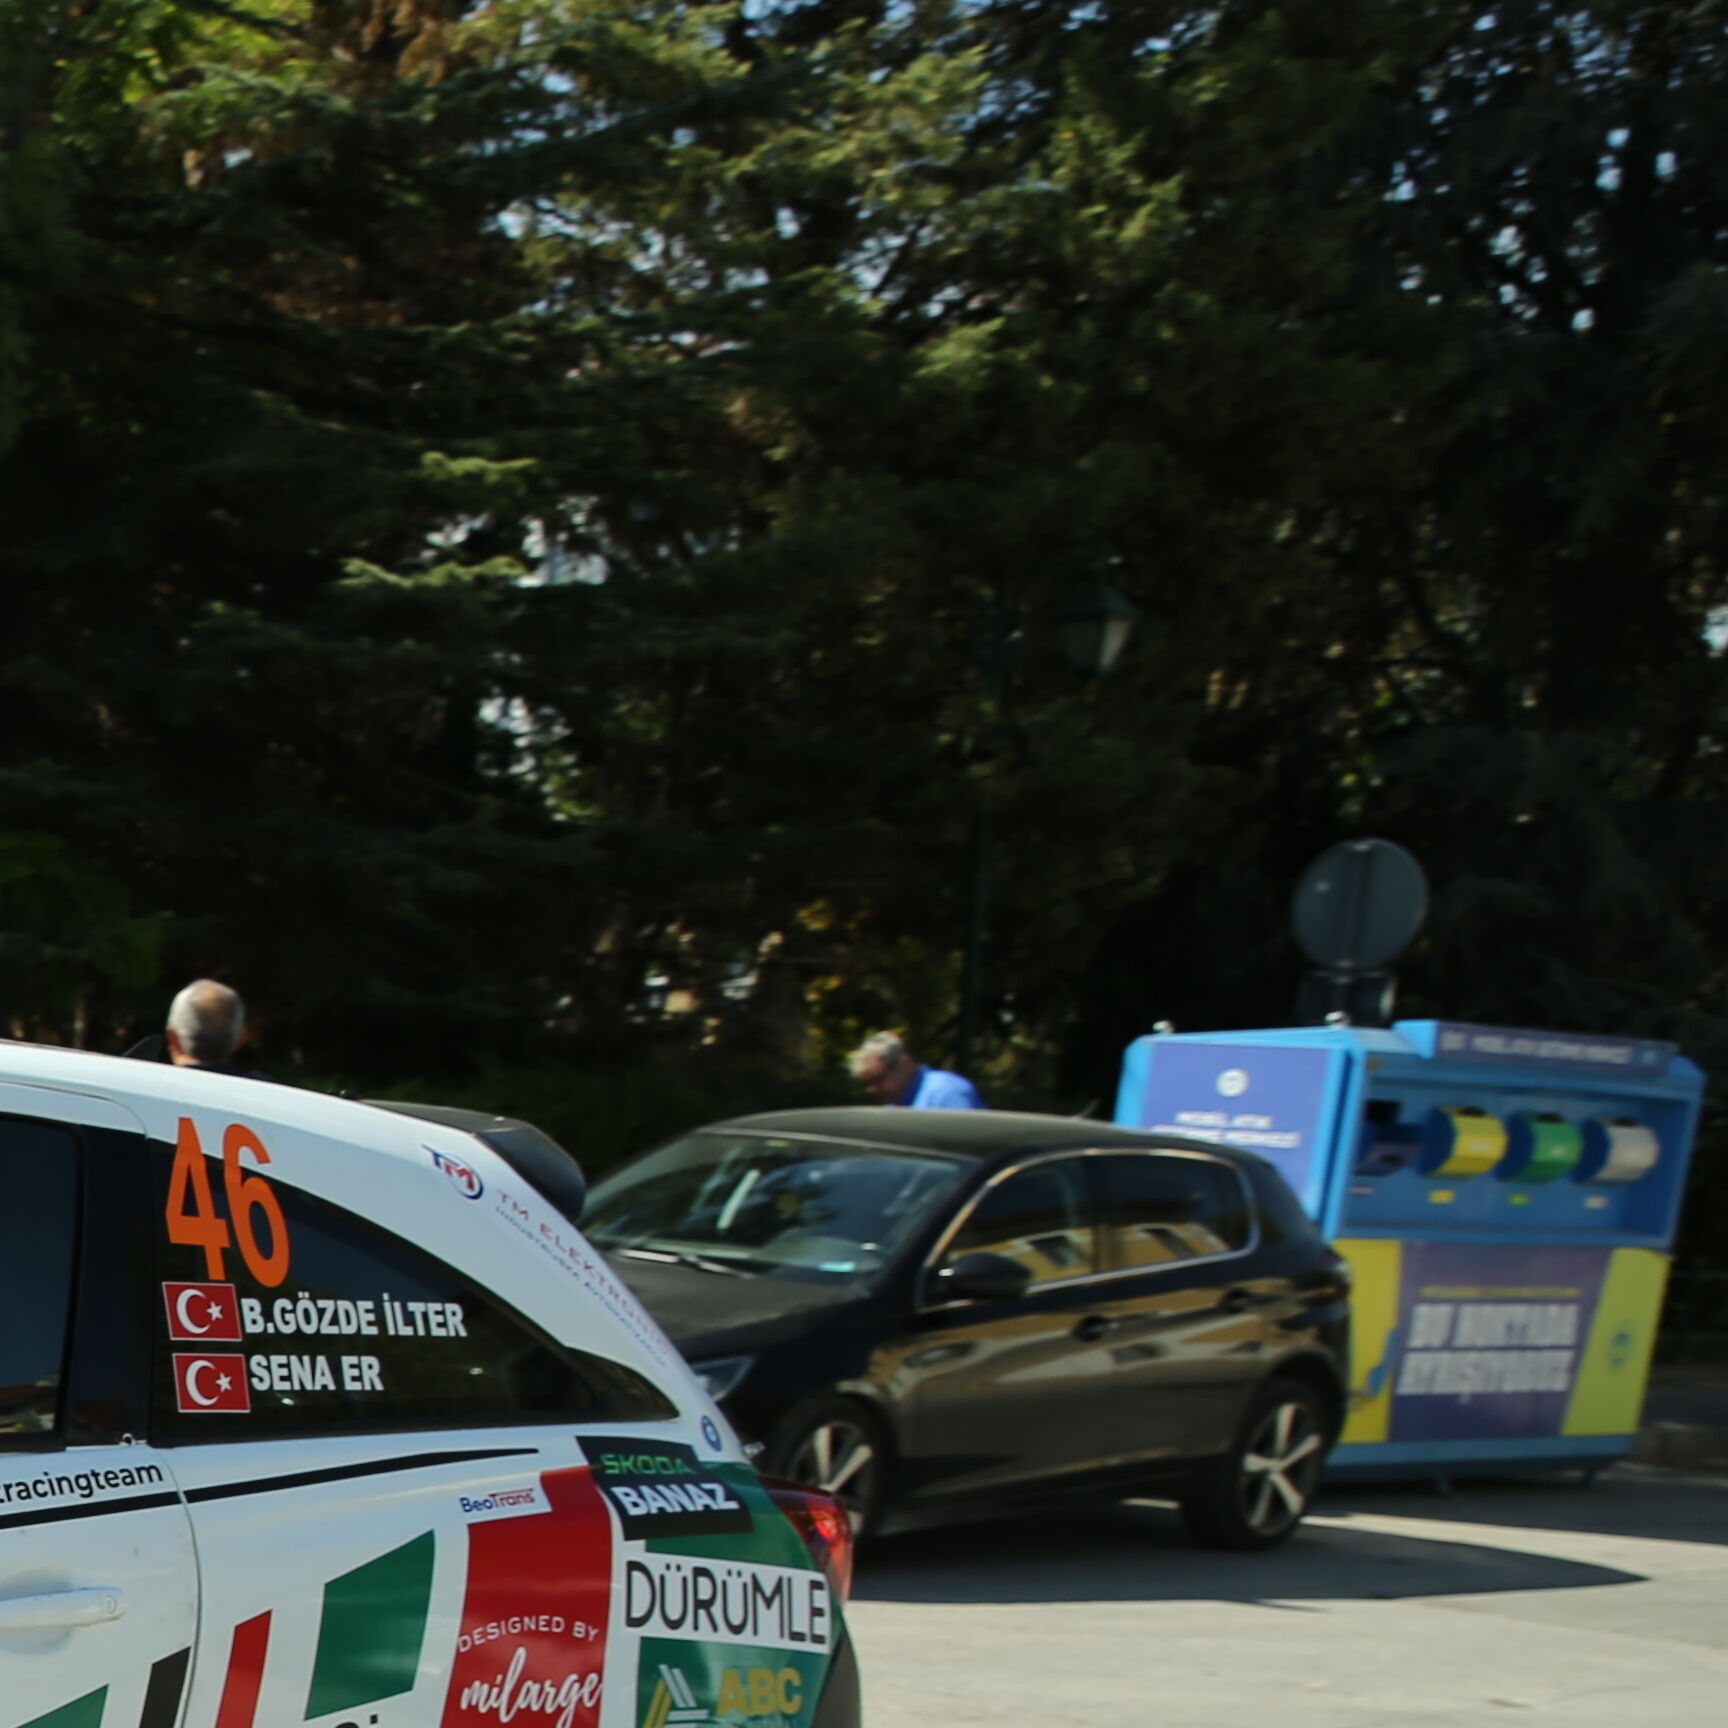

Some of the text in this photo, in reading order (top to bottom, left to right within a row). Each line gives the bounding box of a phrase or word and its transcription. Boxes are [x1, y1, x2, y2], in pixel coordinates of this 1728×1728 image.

[165, 1117, 291, 1287] 46
[241, 1292, 468, 1338] B.GÖZDE İLTER
[250, 1354, 384, 1391] SENA ER
[459, 1488, 536, 1514] BeoTrans
[610, 1482, 740, 1516] BANAZ
[624, 1559, 828, 1645] DÜRÜMLE
[457, 1614, 599, 1653] DESIGNED BY
[716, 1667, 803, 1716] ABC
